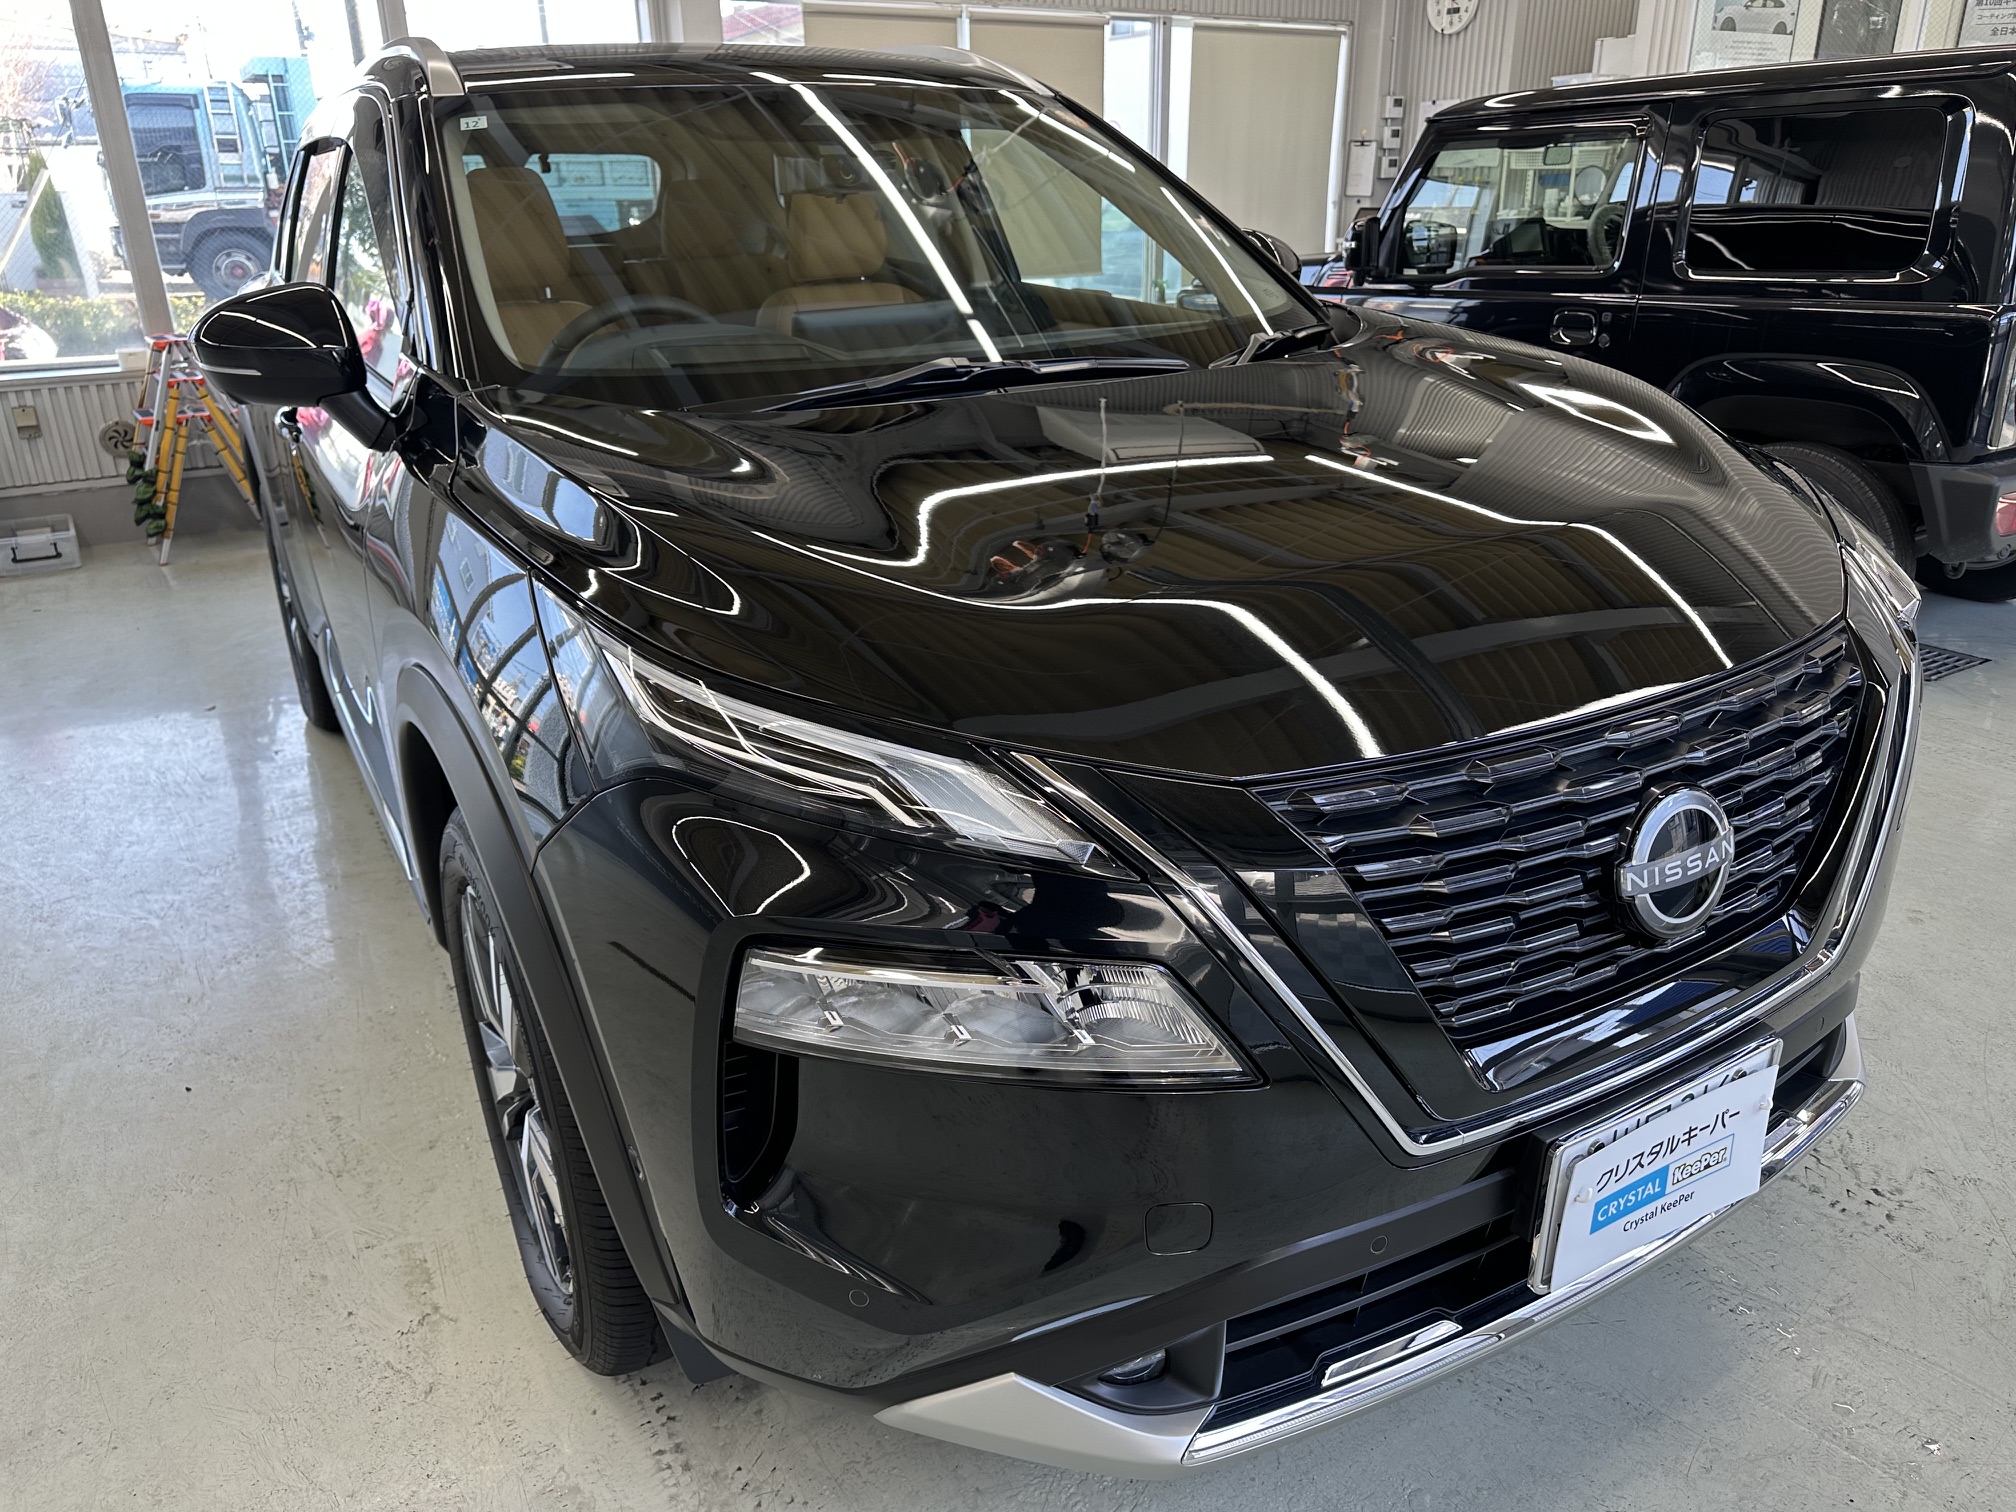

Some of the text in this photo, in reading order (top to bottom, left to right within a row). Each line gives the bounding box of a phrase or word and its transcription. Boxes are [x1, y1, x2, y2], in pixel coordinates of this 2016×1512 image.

[1626, 834, 1734, 892] NISSAN
[1596, 1109, 1741, 1193] クリスタルキーパー
[1596, 1146, 1727, 1222] CRYSTAL KeePer
[1623, 1191, 1695, 1232] Crystal KeePer
